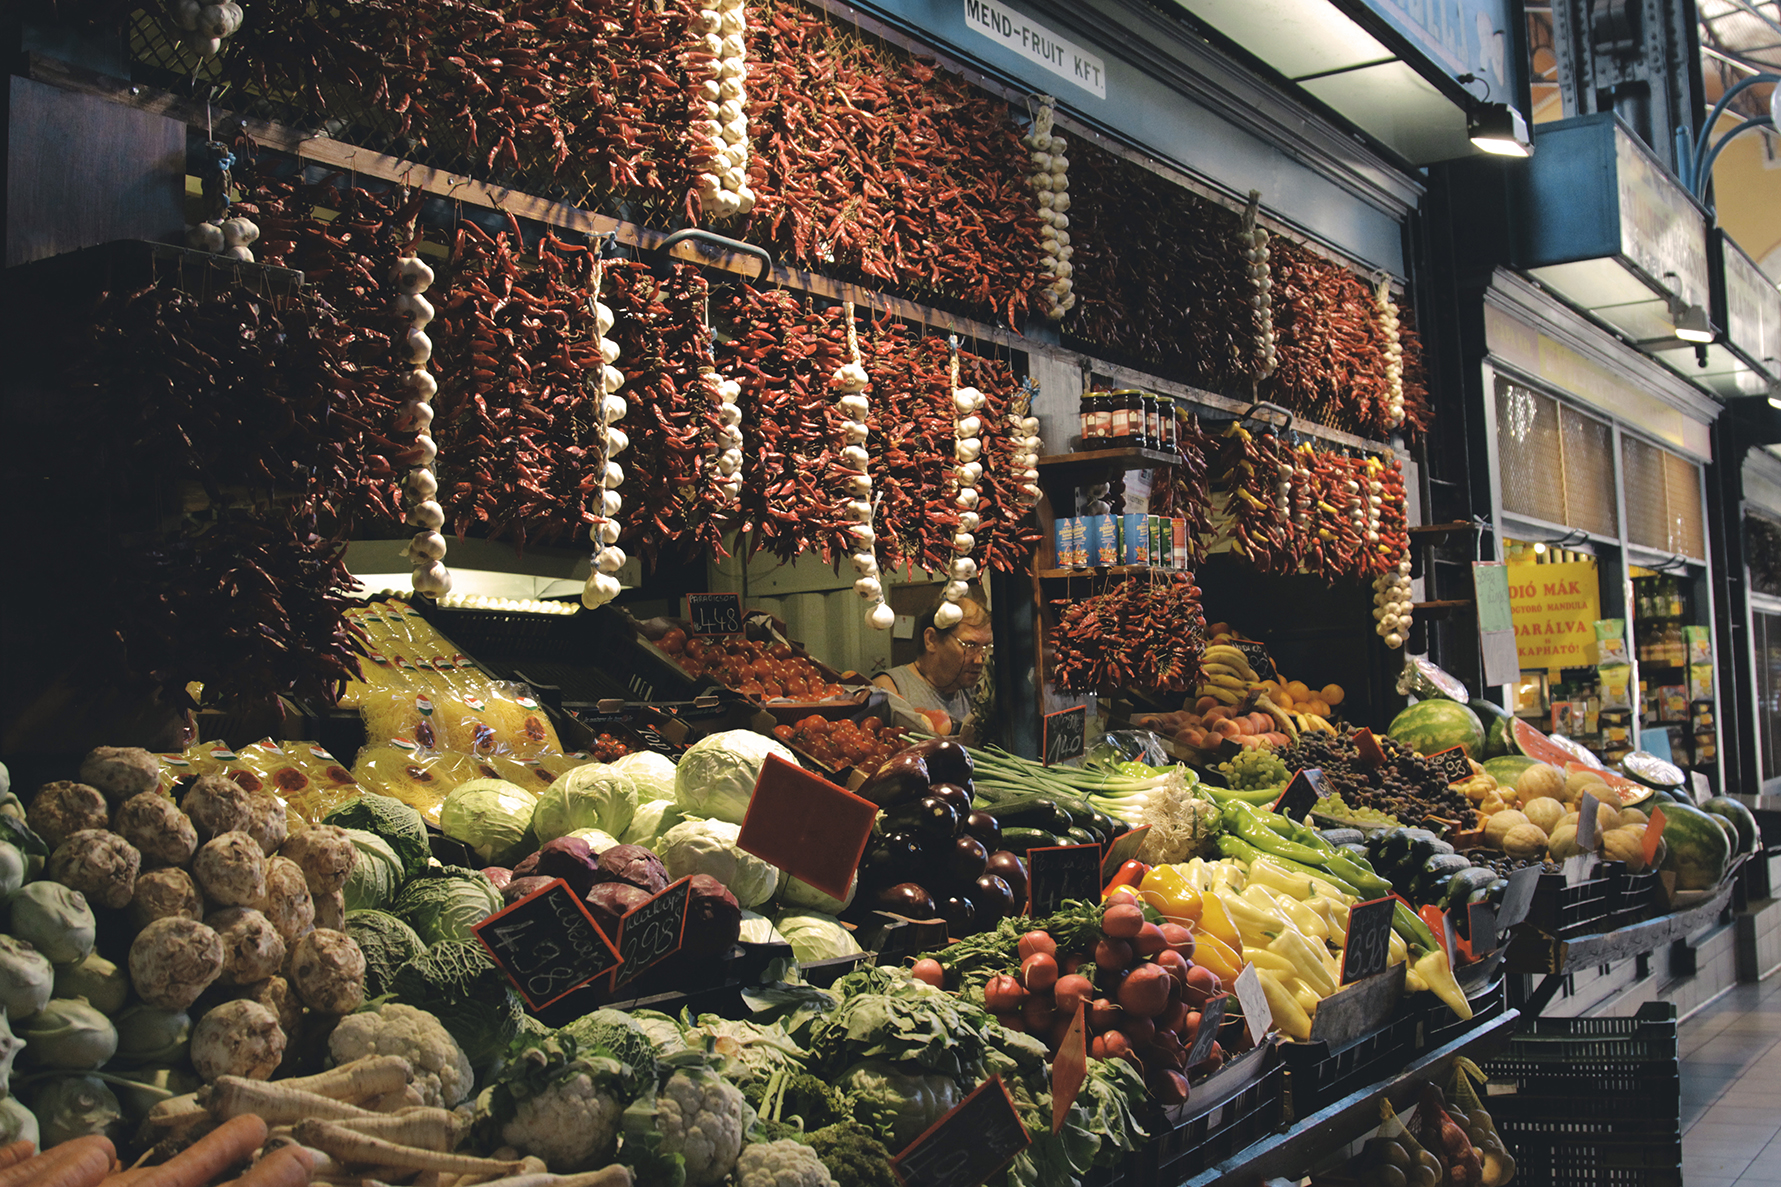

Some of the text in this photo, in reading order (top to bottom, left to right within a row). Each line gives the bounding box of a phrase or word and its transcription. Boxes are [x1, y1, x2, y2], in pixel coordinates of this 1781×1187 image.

[967, 0, 1104, 89] MEND-FRUIT KFT.
[1508, 581, 1537, 599] DIÓ
[1543, 579, 1581, 596] MÁK
[1511, 601, 1588, 614] OGYORÓ MANDULA
[700, 608, 738, 633] 448
[1518, 642, 1580, 657] KAPHATÓ!
[1346, 924, 1389, 978] 398
